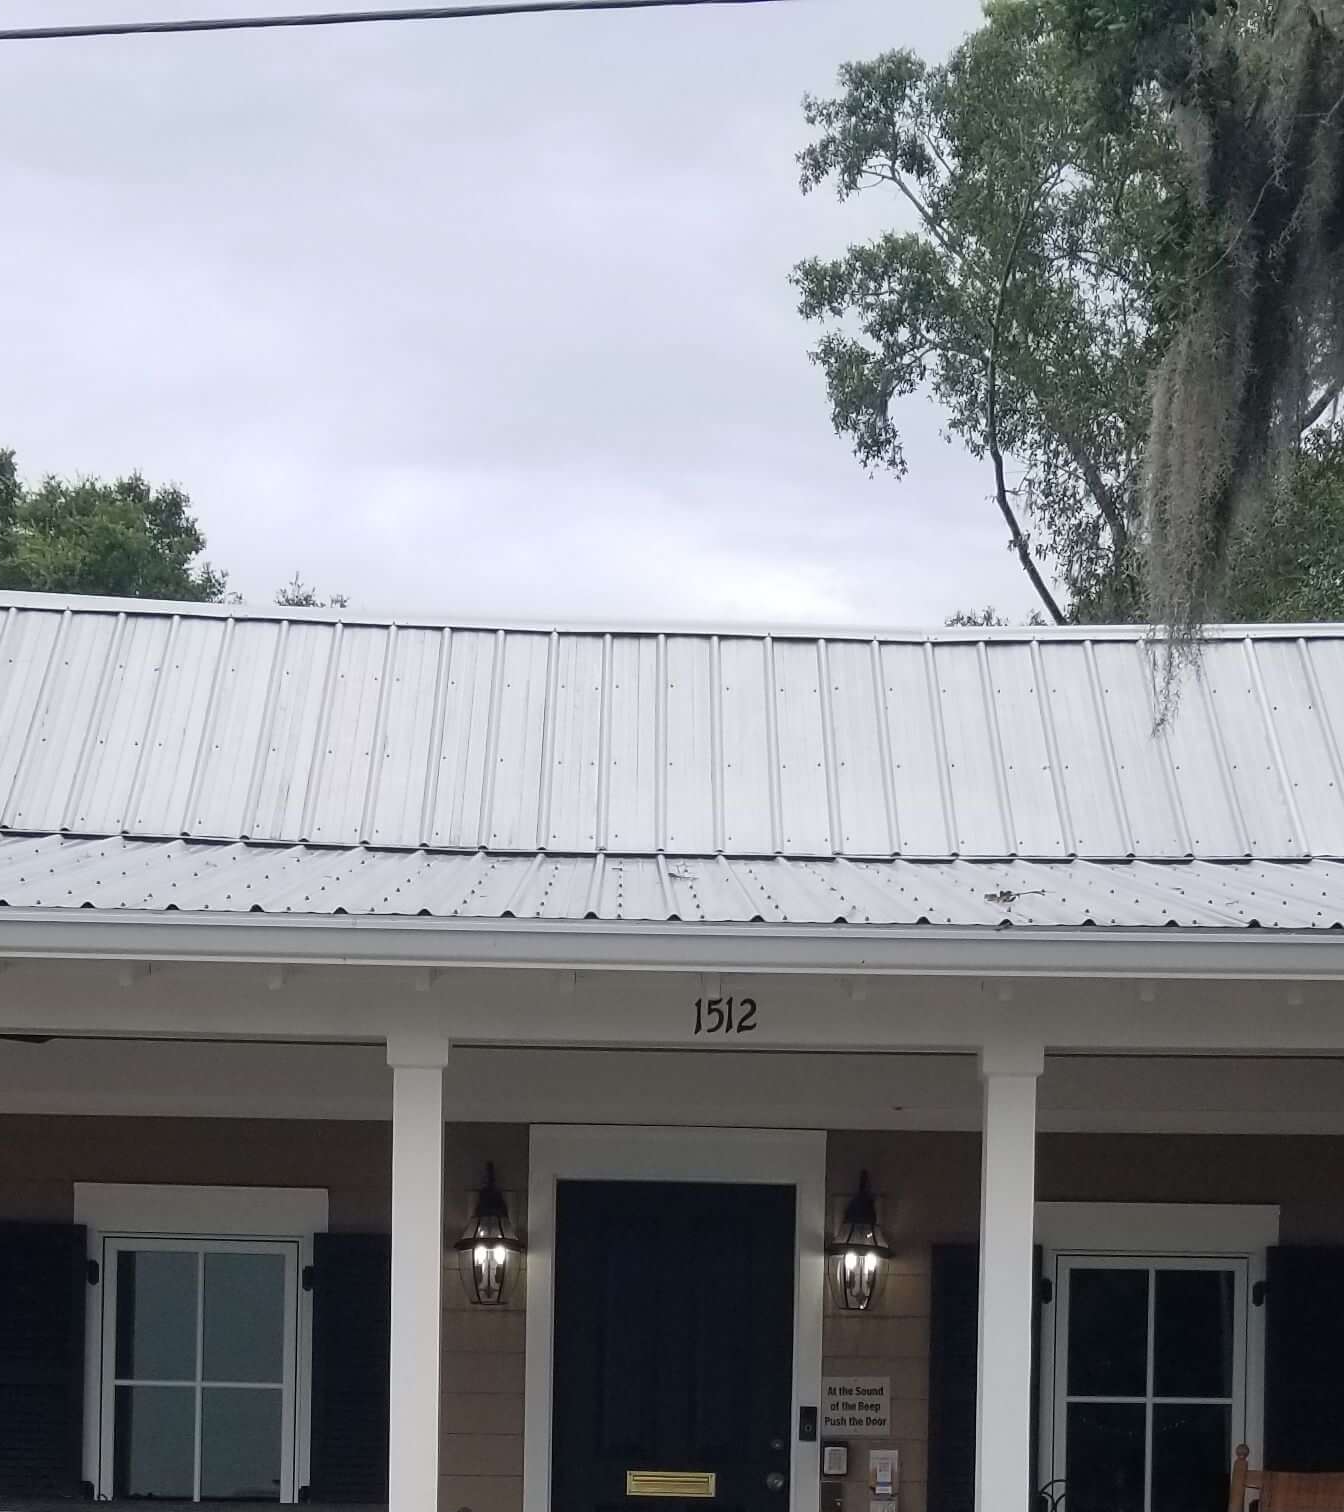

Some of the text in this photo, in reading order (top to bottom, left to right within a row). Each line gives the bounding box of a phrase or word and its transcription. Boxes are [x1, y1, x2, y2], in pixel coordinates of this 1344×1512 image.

[694, 996, 757, 1034] 1512
[827, 1386, 884, 1396] At the Sound
[830, 1402, 881, 1413] of the Beep
[824, 1416, 887, 1426] Push the Door
